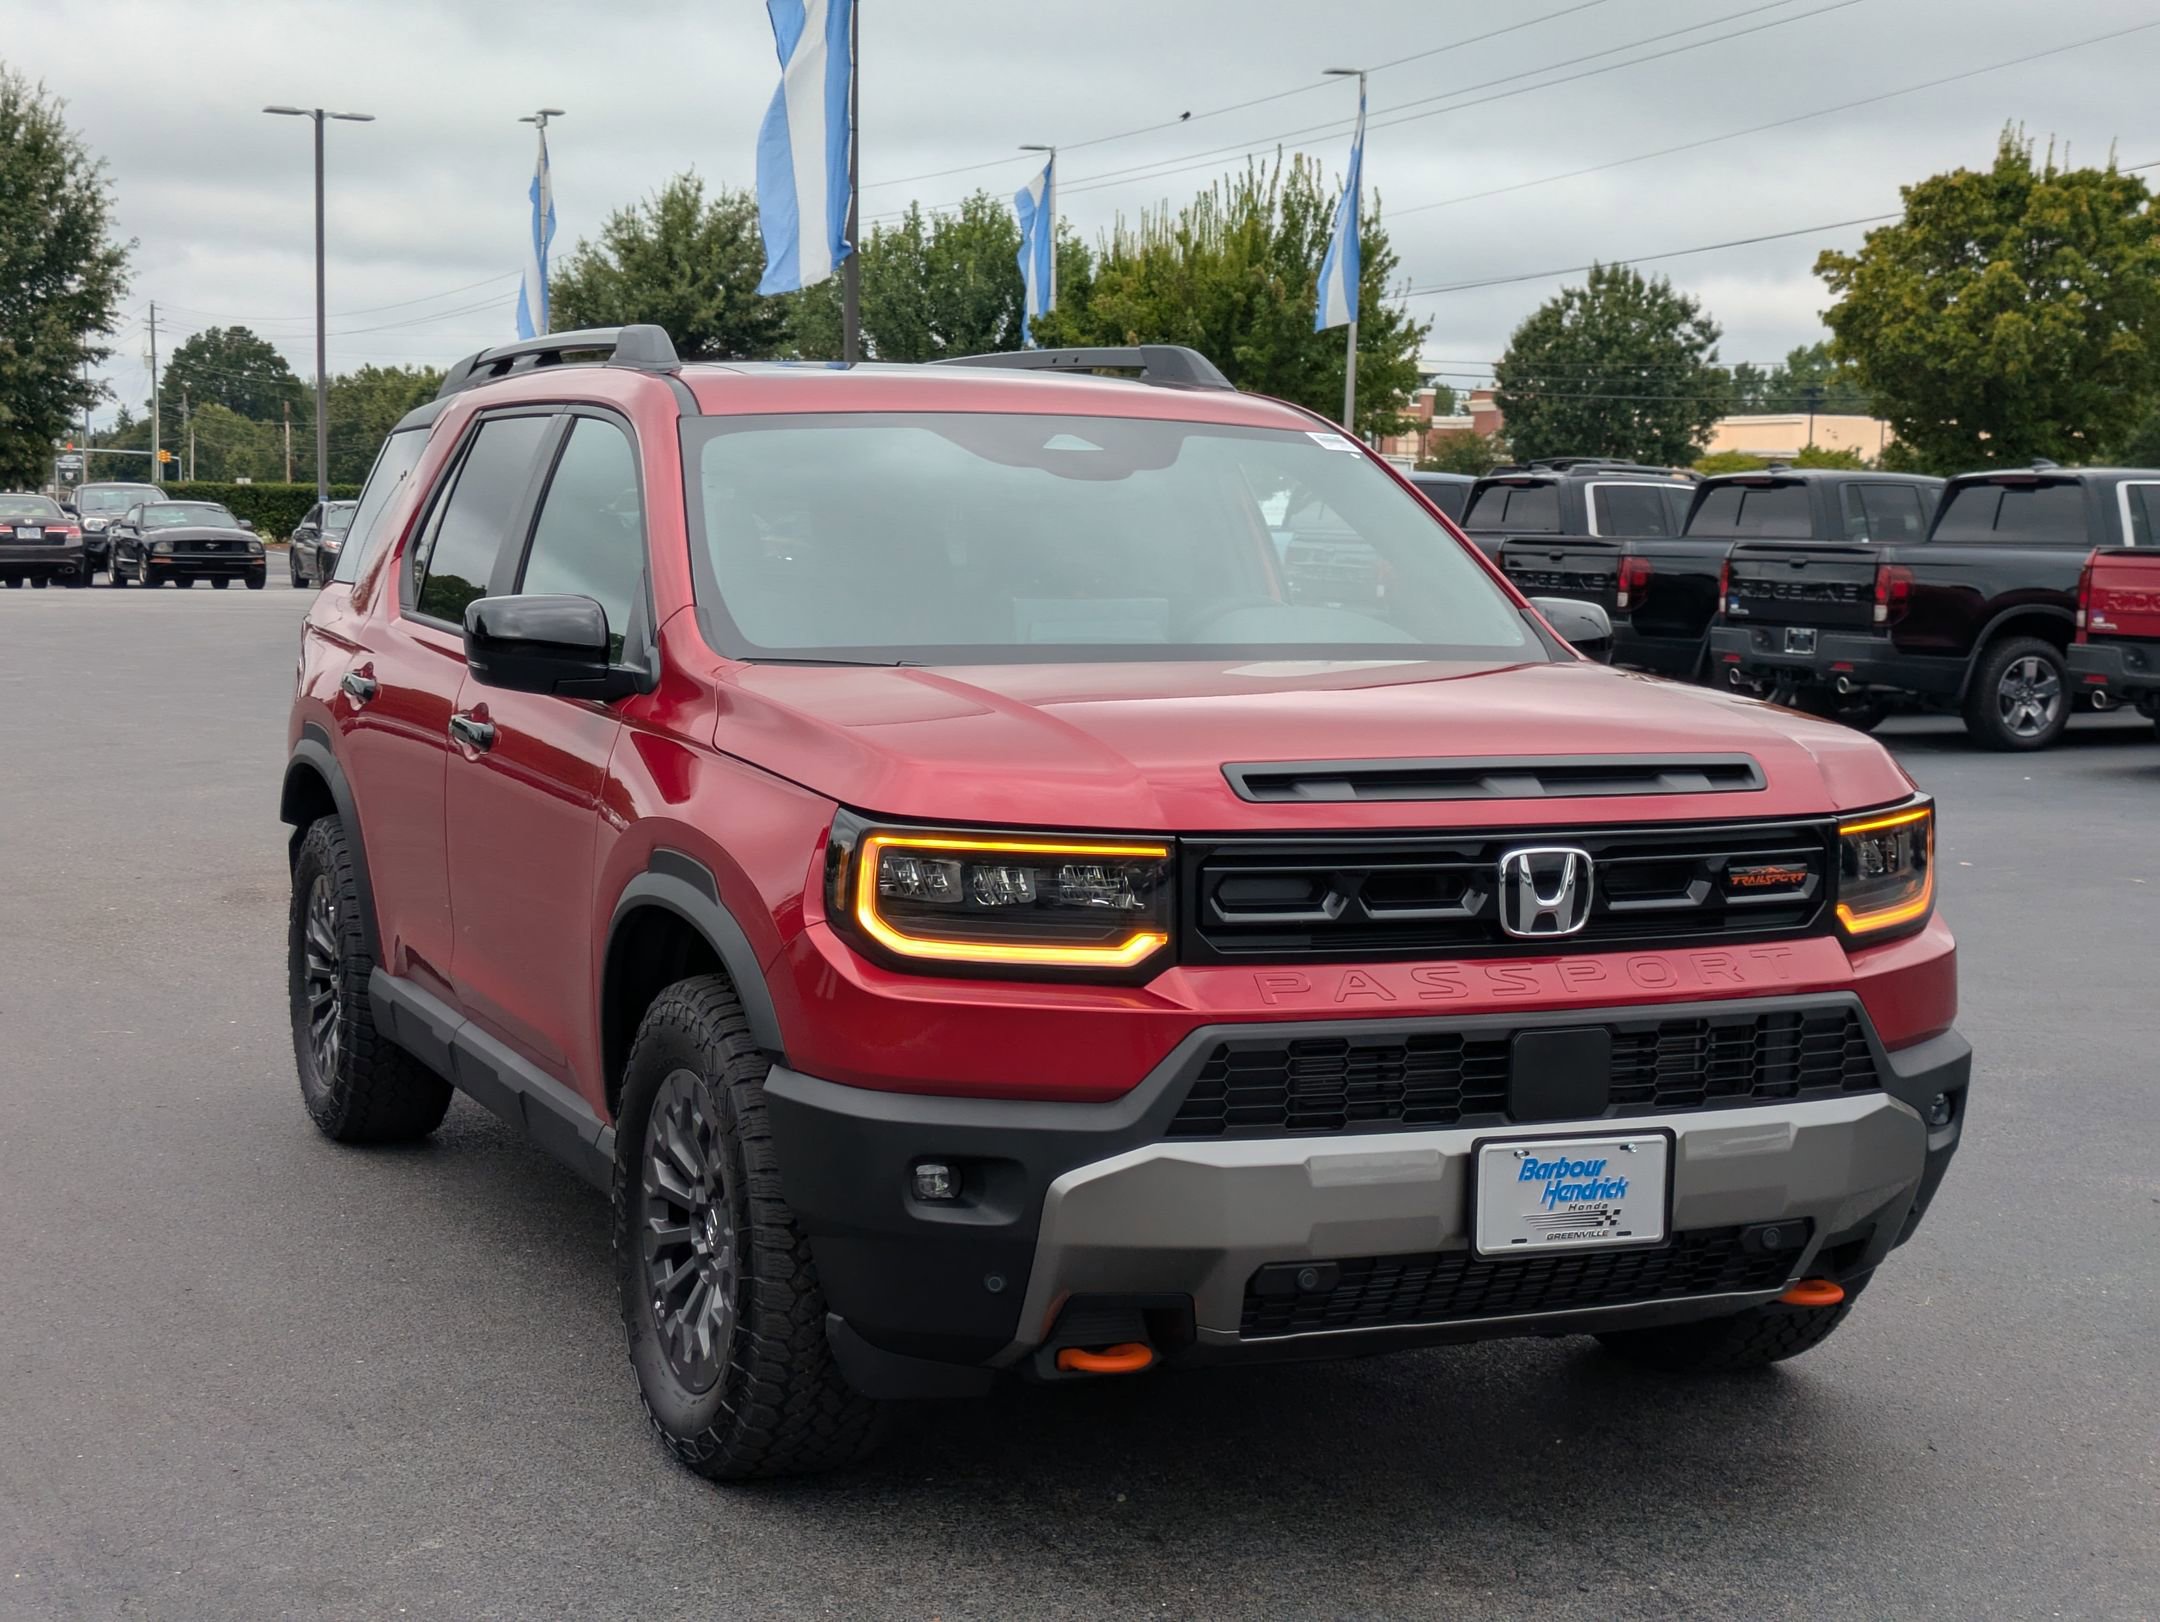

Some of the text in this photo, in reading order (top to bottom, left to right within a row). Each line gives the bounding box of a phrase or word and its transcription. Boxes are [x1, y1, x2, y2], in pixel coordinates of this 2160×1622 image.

[1253, 946, 1793, 1006] PASSPORT
[1518, 1157, 1608, 1182] Barbour
[1540, 1175, 1630, 1211] Hendrick
[1568, 1202, 1608, 1212] Honda
[1546, 1229, 1610, 1241] GREENVILLE
